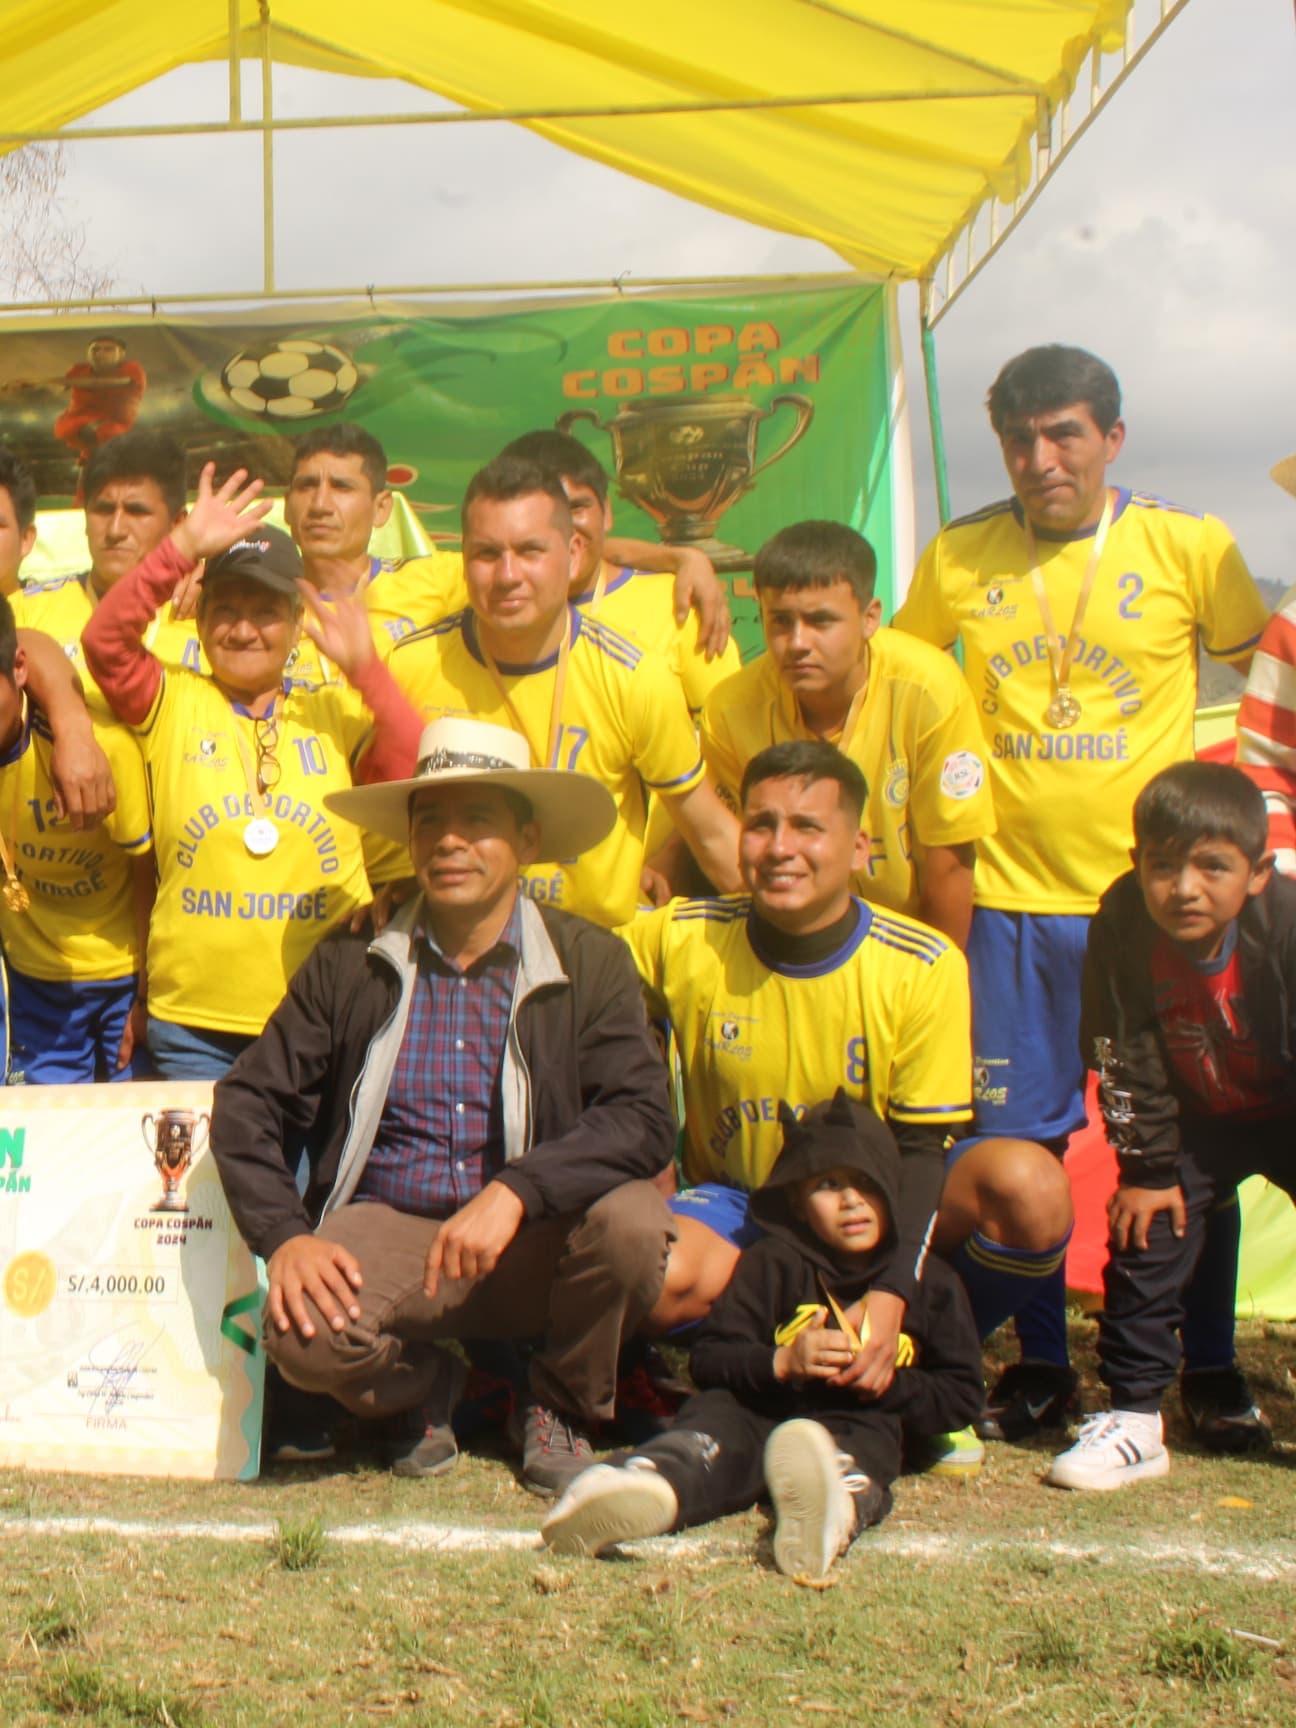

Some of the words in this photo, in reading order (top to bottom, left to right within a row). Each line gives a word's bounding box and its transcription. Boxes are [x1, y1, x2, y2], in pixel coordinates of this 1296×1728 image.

[608, 322, 780, 359] COPA
[562, 352, 820, 398] COSPÁN
[1117, 572, 1145, 620] 2
[292, 735, 328, 777] 10
[992, 731, 1033, 761] SAN
[1036, 727, 1129, 761] JORGÉ
[177, 803, 221, 869] CLUB
[181, 886, 233, 918] SAN
[238, 886, 328, 921] JORGÉ
[846, 1036, 870, 1085] 8
[134, 1217, 164, 1230] COPA
[166, 1215, 213, 1230] COSPÁN
[156, 1234, 187, 1246] 2024
